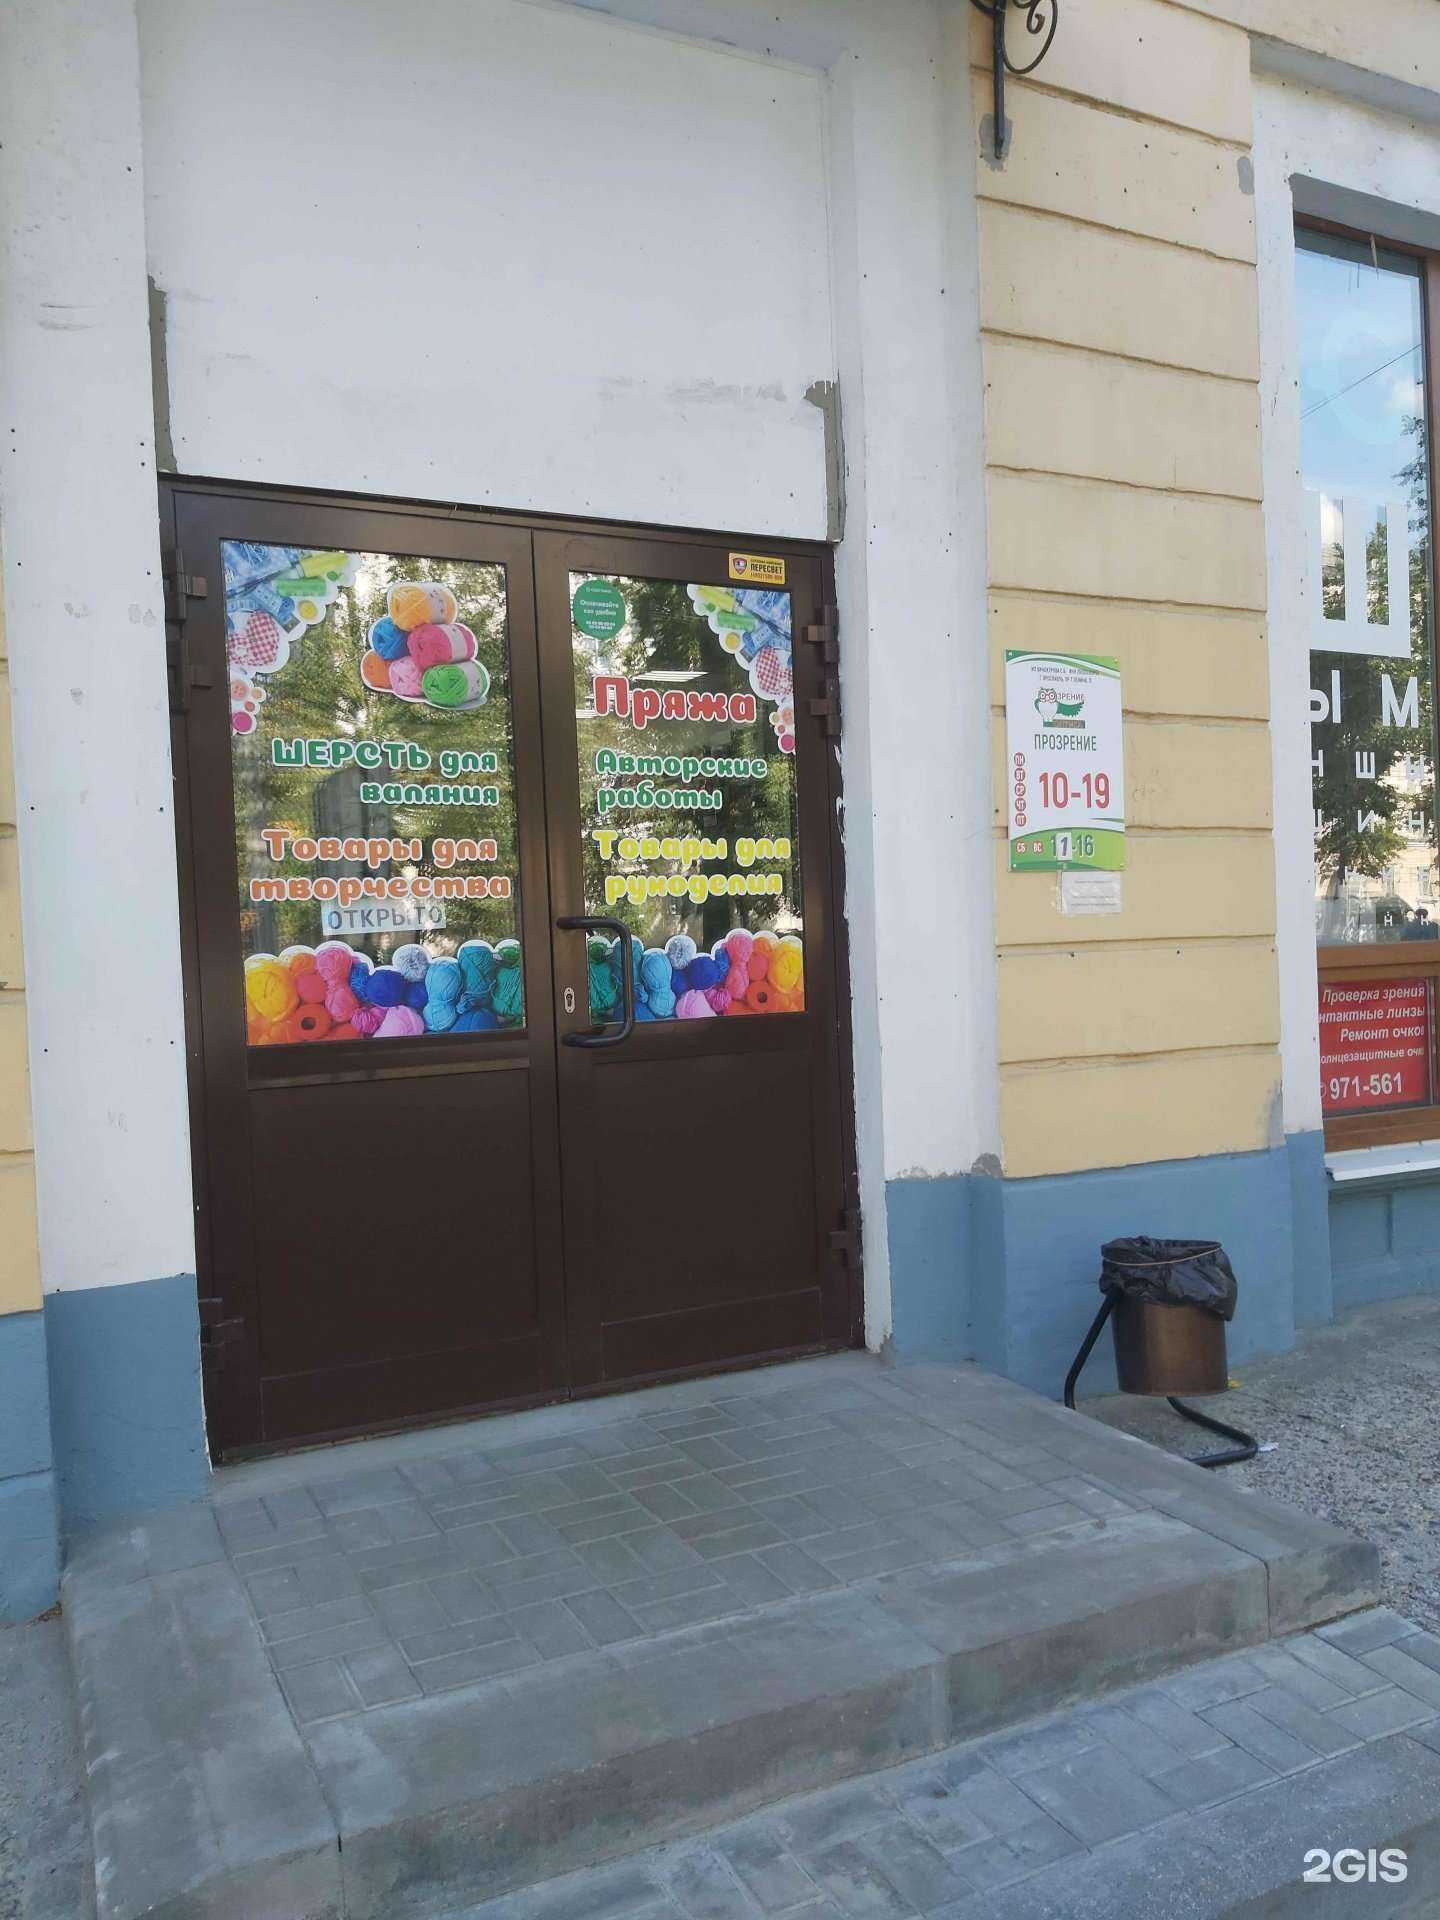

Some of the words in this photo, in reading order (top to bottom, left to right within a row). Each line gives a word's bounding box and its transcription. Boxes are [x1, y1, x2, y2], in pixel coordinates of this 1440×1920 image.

[593, 675, 757, 729] Пряжа
[1381, 673, 1419, 728] М
[1034, 733, 1097, 751] ПРОЗРЕНИЕ
[272, 737, 432, 771] ШЕРСТЬ
[439, 750, 498, 778] для
[596, 748, 768, 783] Авторские
[1015, 752, 1024, 765] ПН
[1016, 769, 1024, 781] ВТ
[360, 783, 499, 805] валяния
[597, 780, 722, 813] работы
[1016, 799, 1025, 811] ЧТ
[1039, 772, 1110, 809] 10-19
[261, 829, 422, 869] Товары
[433, 838, 497, 868] для
[592, 830, 727, 870] Товары
[736, 838, 791, 867] для
[1016, 842, 1026, 853] СБ
[1033, 842, 1042, 853] ВС
[250, 876, 511, 907] творчества
[605, 874, 783, 905] рукоделия
[328, 906, 443, 930] ОТКРЫТО
[1322, 988, 1380, 1005] Проверка
[1383, 986, 1425, 1002] зрения
[1386, 1006, 1424, 1019] линзы
[1340, 1028, 1389, 1042] Ремонт
[1330, 1071, 1402, 1100] 971-561
